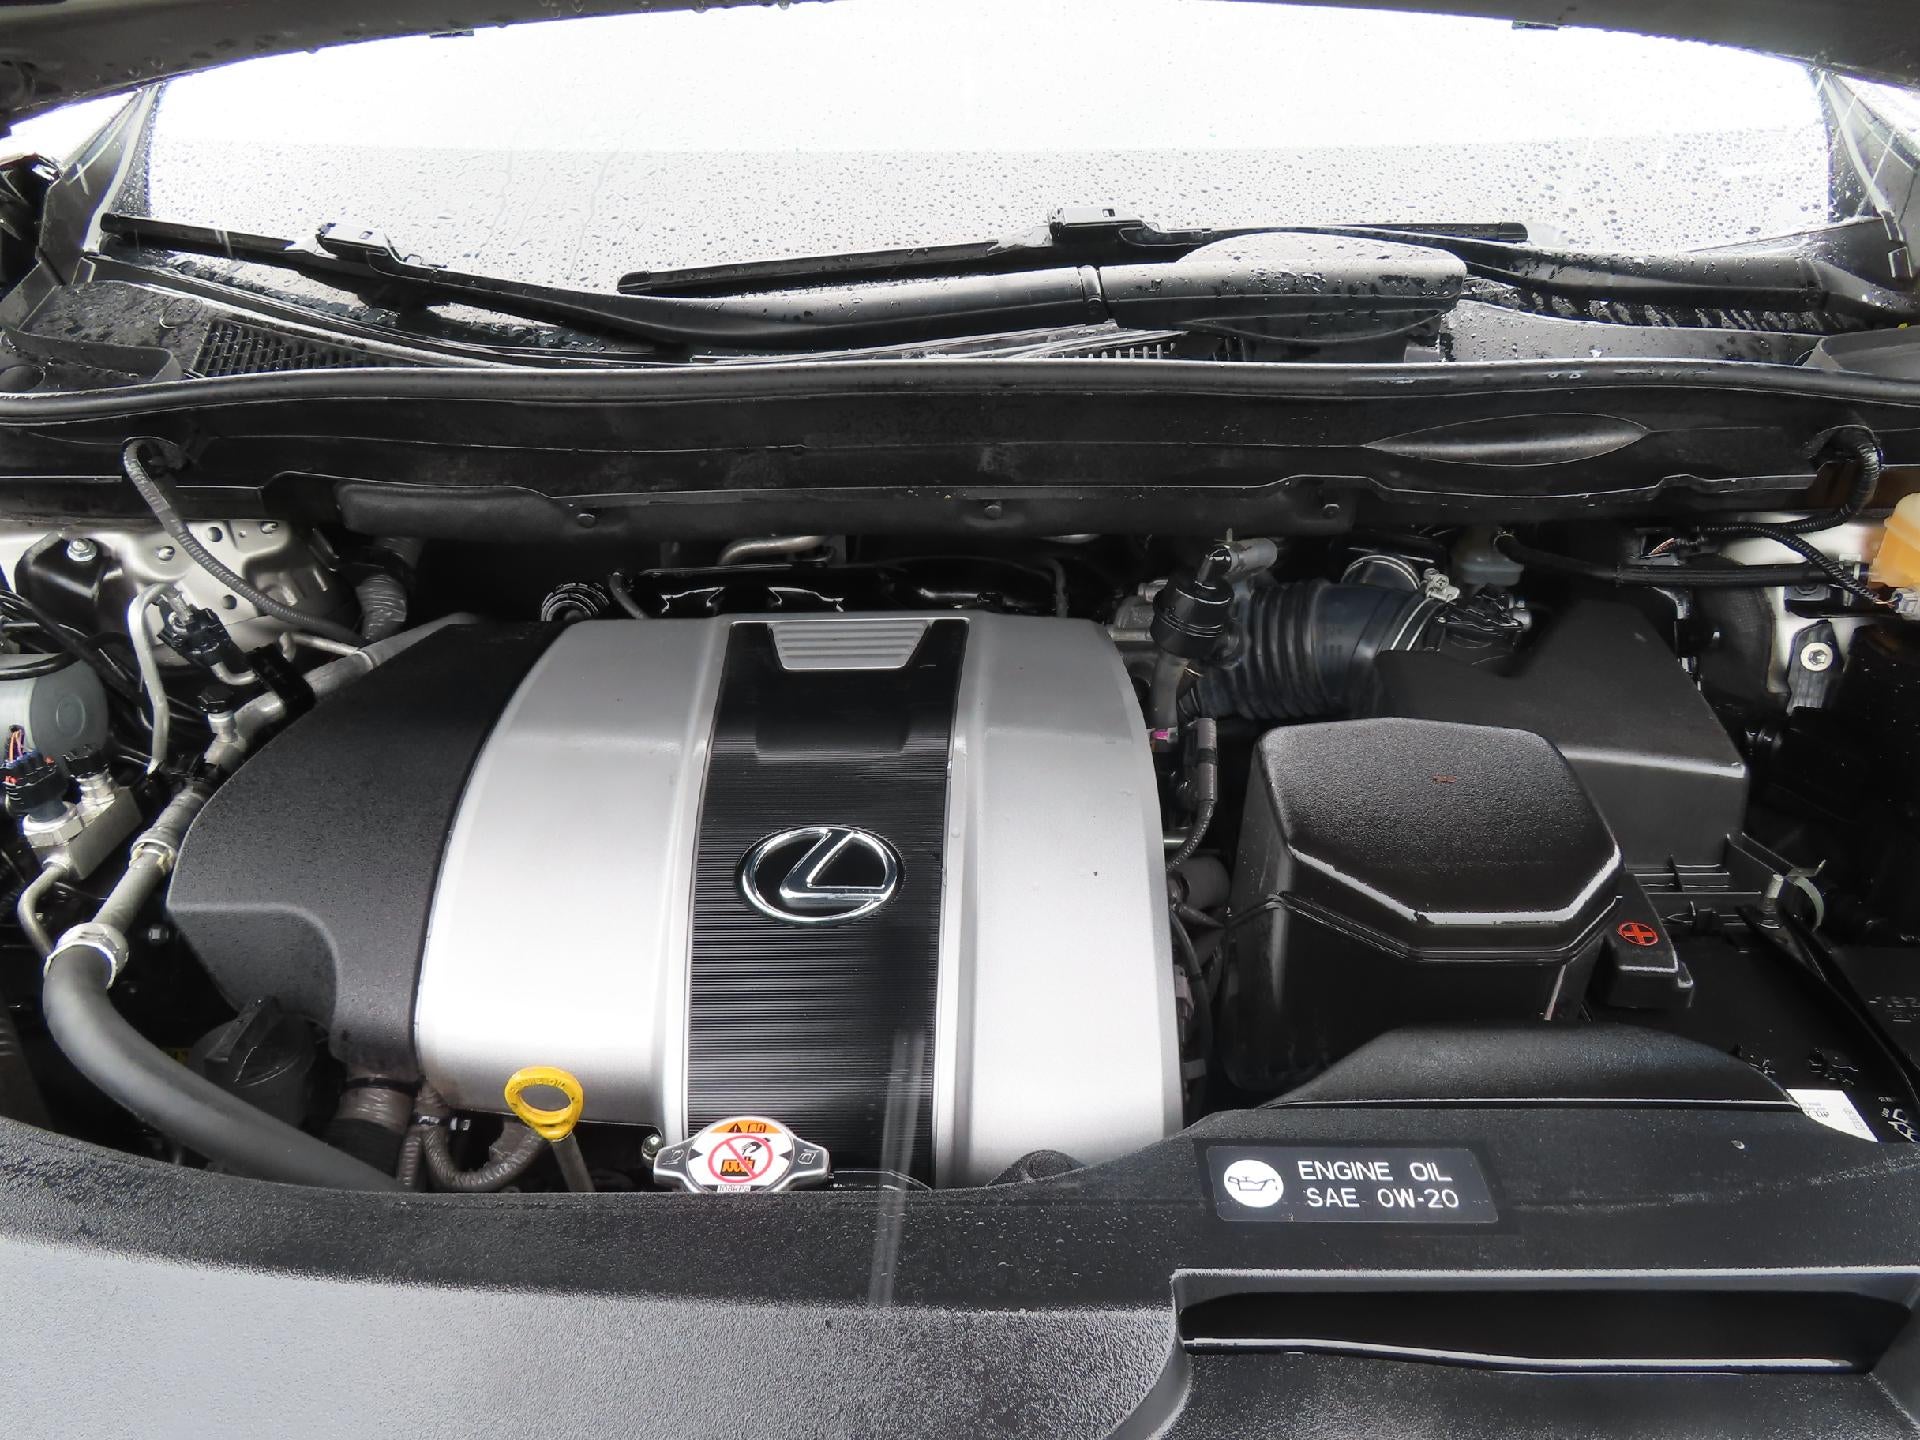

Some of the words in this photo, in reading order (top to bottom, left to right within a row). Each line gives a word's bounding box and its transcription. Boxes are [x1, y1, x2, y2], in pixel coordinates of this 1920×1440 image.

[1297, 1160, 1394, 1182] ENGINE
[1409, 1161, 1453, 1183] OIL
[1305, 1187, 1361, 1209] SAE
[1376, 1187, 1460, 1209] 0W-20
